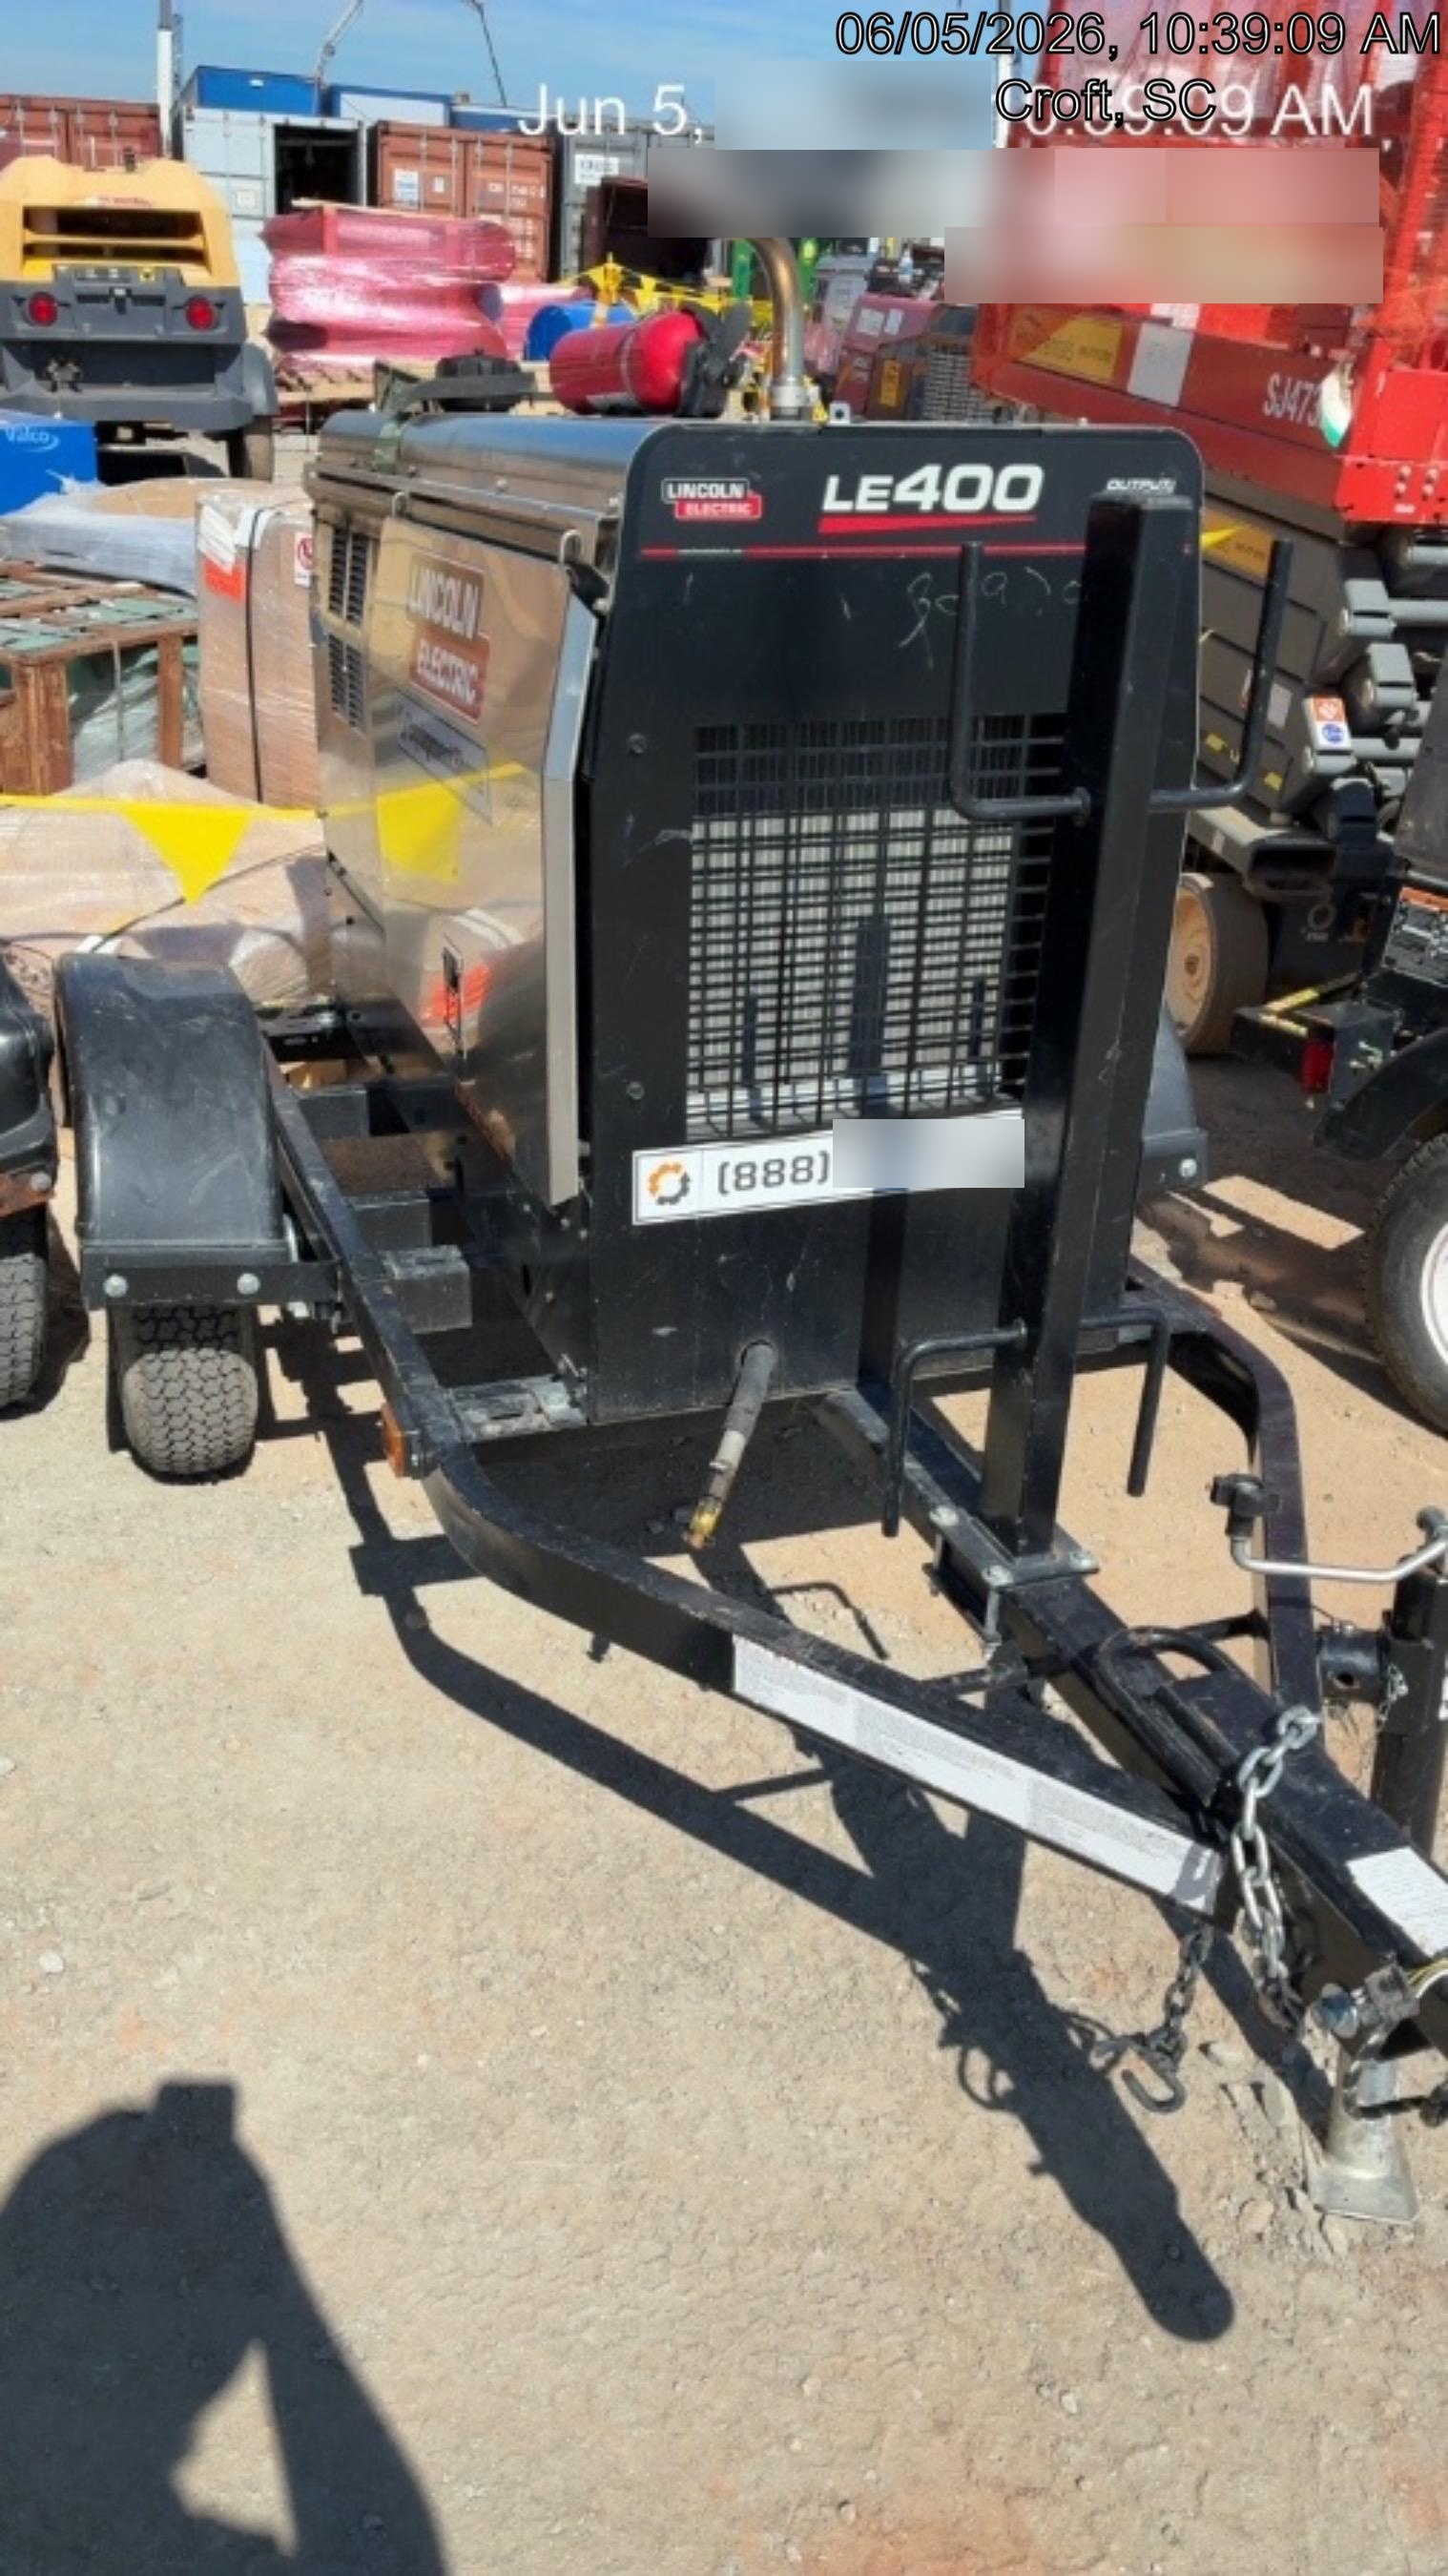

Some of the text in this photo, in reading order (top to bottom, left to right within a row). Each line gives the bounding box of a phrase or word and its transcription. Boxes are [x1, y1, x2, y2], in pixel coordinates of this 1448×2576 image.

[667, 483, 745, 499] LINCOLN
[686, 502, 754, 516] ELECTRIC
[821, 462, 1045, 513] LE400
[411, 563, 481, 641] LINCOLN
[416, 637, 478, 704] ELECTRIC
[717, 1150, 830, 1195] (888)
